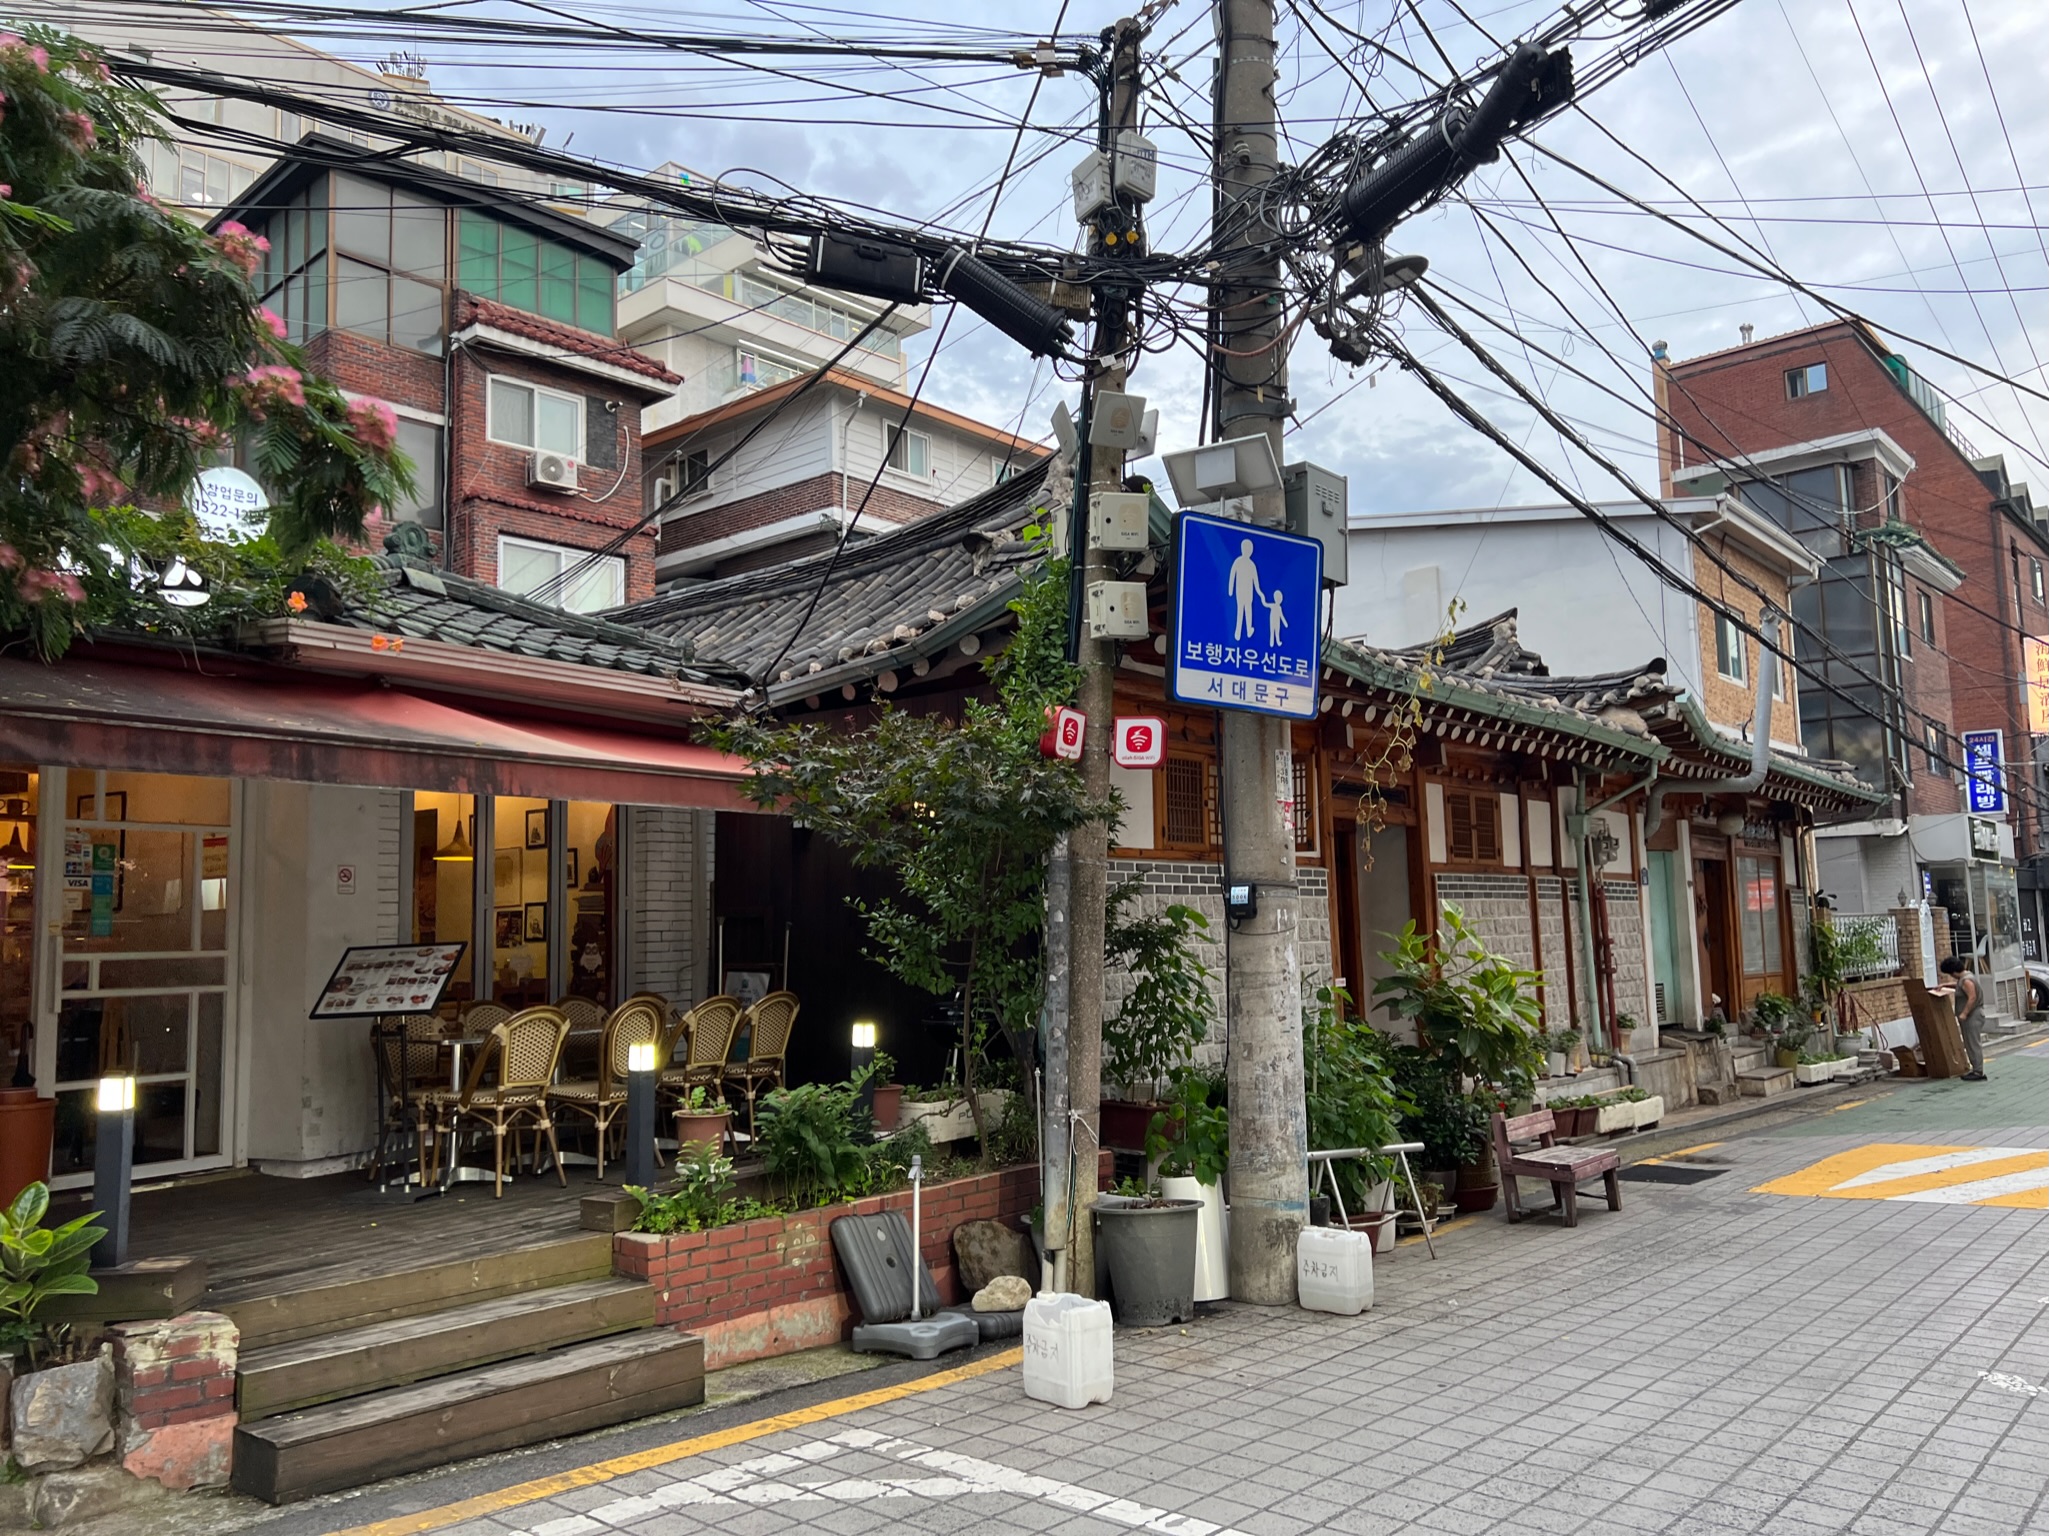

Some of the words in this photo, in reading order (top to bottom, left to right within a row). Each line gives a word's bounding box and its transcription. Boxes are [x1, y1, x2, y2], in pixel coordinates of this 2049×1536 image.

[206, 482, 258, 506] 창업문의
[1185, 640, 1310, 679] 보행자우선도로
[1207, 677, 1290, 707] 서대문구
[1968, 735, 1995, 744] 24시간
[68, 879, 89, 887] VISA
